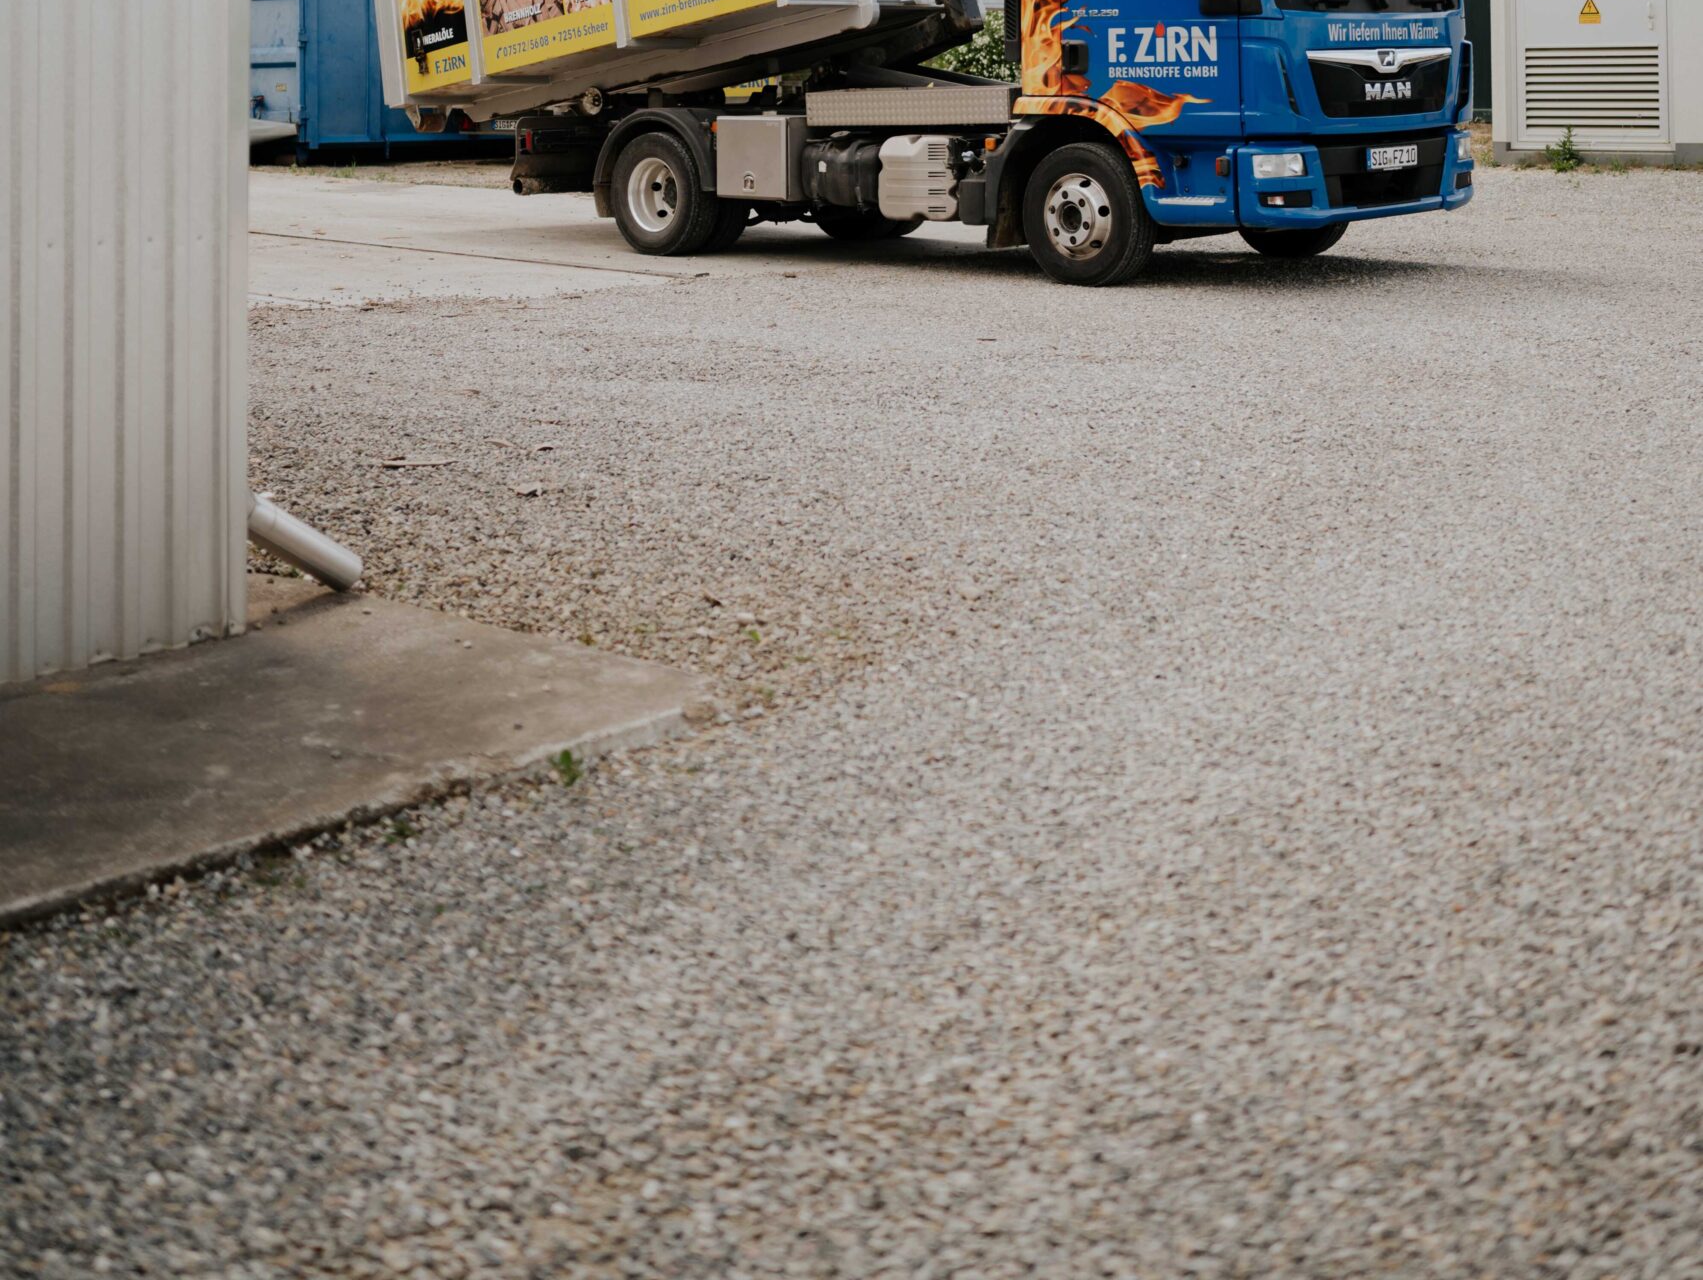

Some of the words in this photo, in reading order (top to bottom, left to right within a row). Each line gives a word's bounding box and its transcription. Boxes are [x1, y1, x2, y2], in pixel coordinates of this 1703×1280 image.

[503, 3, 542, 23] BRENNHOLZ
[1088, 8, 1120, 18] 12.250
[558, 26, 582, 42] 72516
[584, 22, 609, 36] Scheer
[1328, 23, 1347, 42] Wir
[1348, 22, 1380, 41] liefern
[1382, 22, 1408, 41] Ihnen
[1409, 22, 1439, 40] Wärme
[1108, 27, 1127, 63] F.
[435, 61, 442, 74] F.
[1108, 65, 1181, 79] BRENNSTOFFE
[1184, 65, 1219, 78] GMBH
[1364, 81, 1412, 101] MAN
[1371, 150, 1388, 166] SIG
